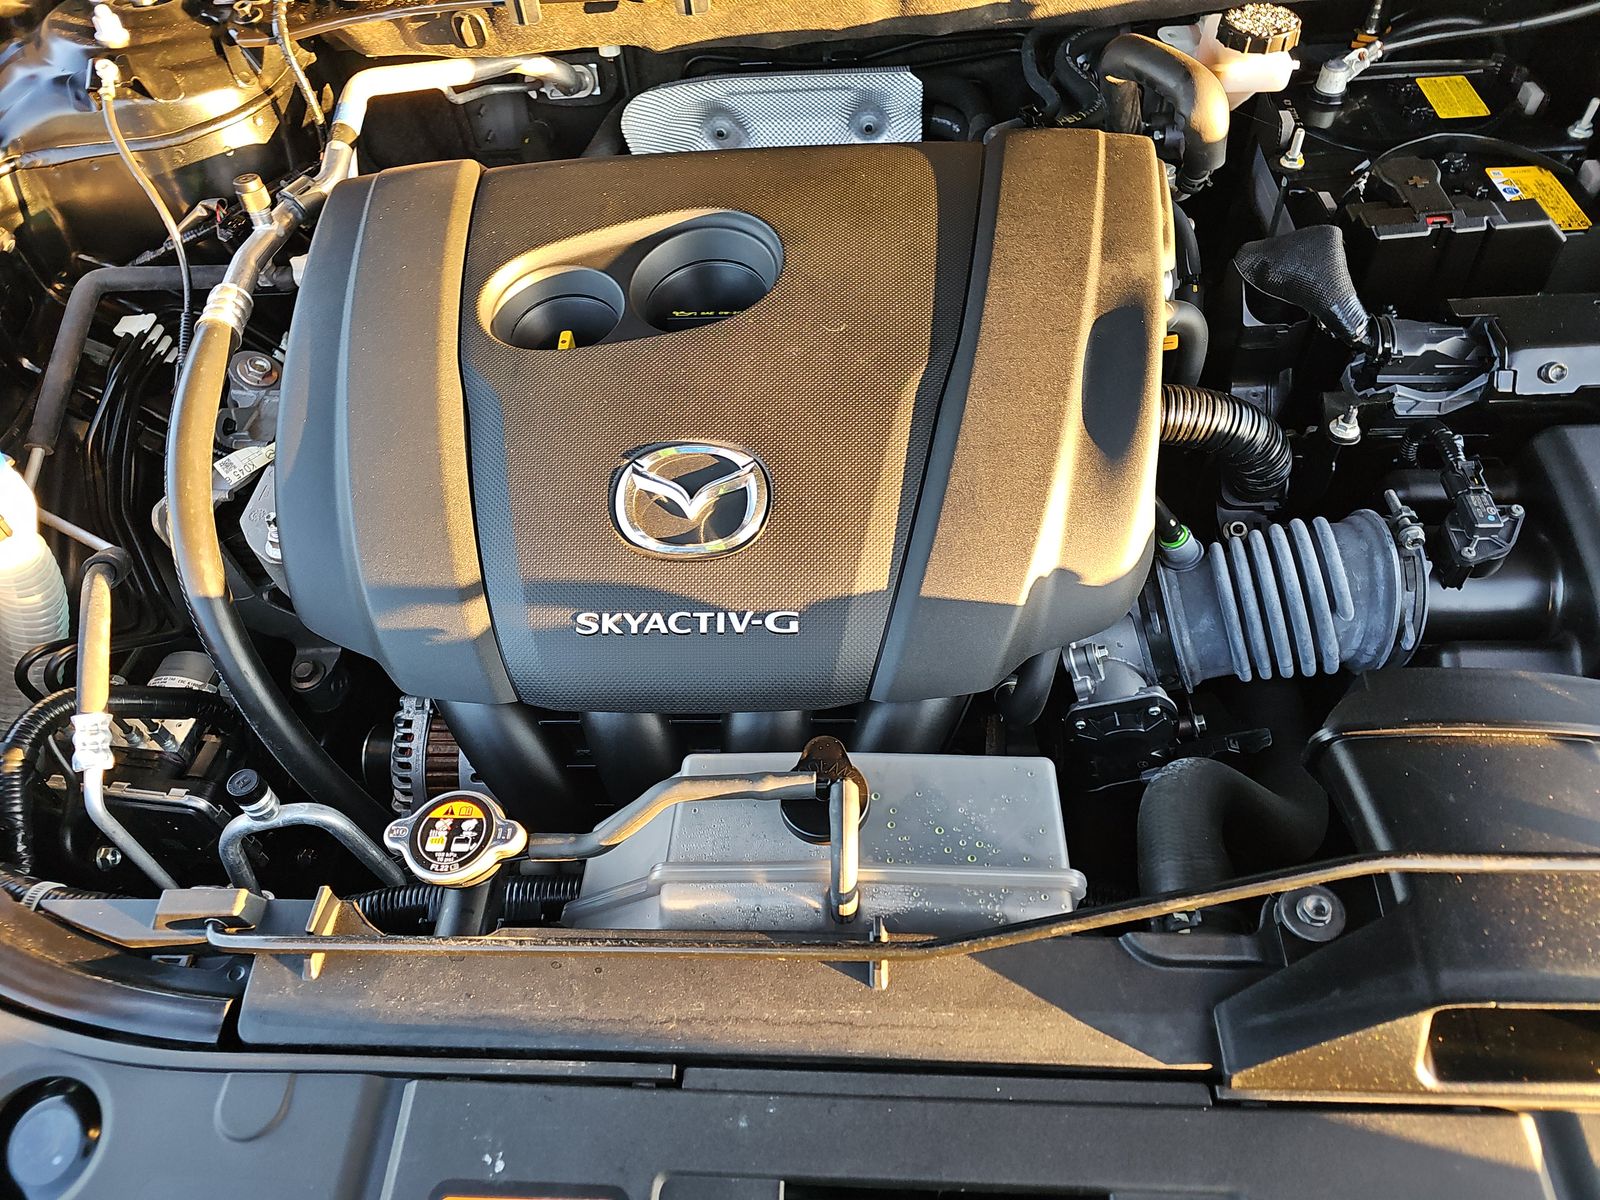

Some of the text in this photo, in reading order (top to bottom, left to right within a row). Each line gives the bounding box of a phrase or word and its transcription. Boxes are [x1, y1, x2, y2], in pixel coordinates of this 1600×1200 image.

[575, 611, 799, 635] SKYACTIV-G
[496, 827, 513, 840] 1.1
[429, 863, 449, 872] FL22
